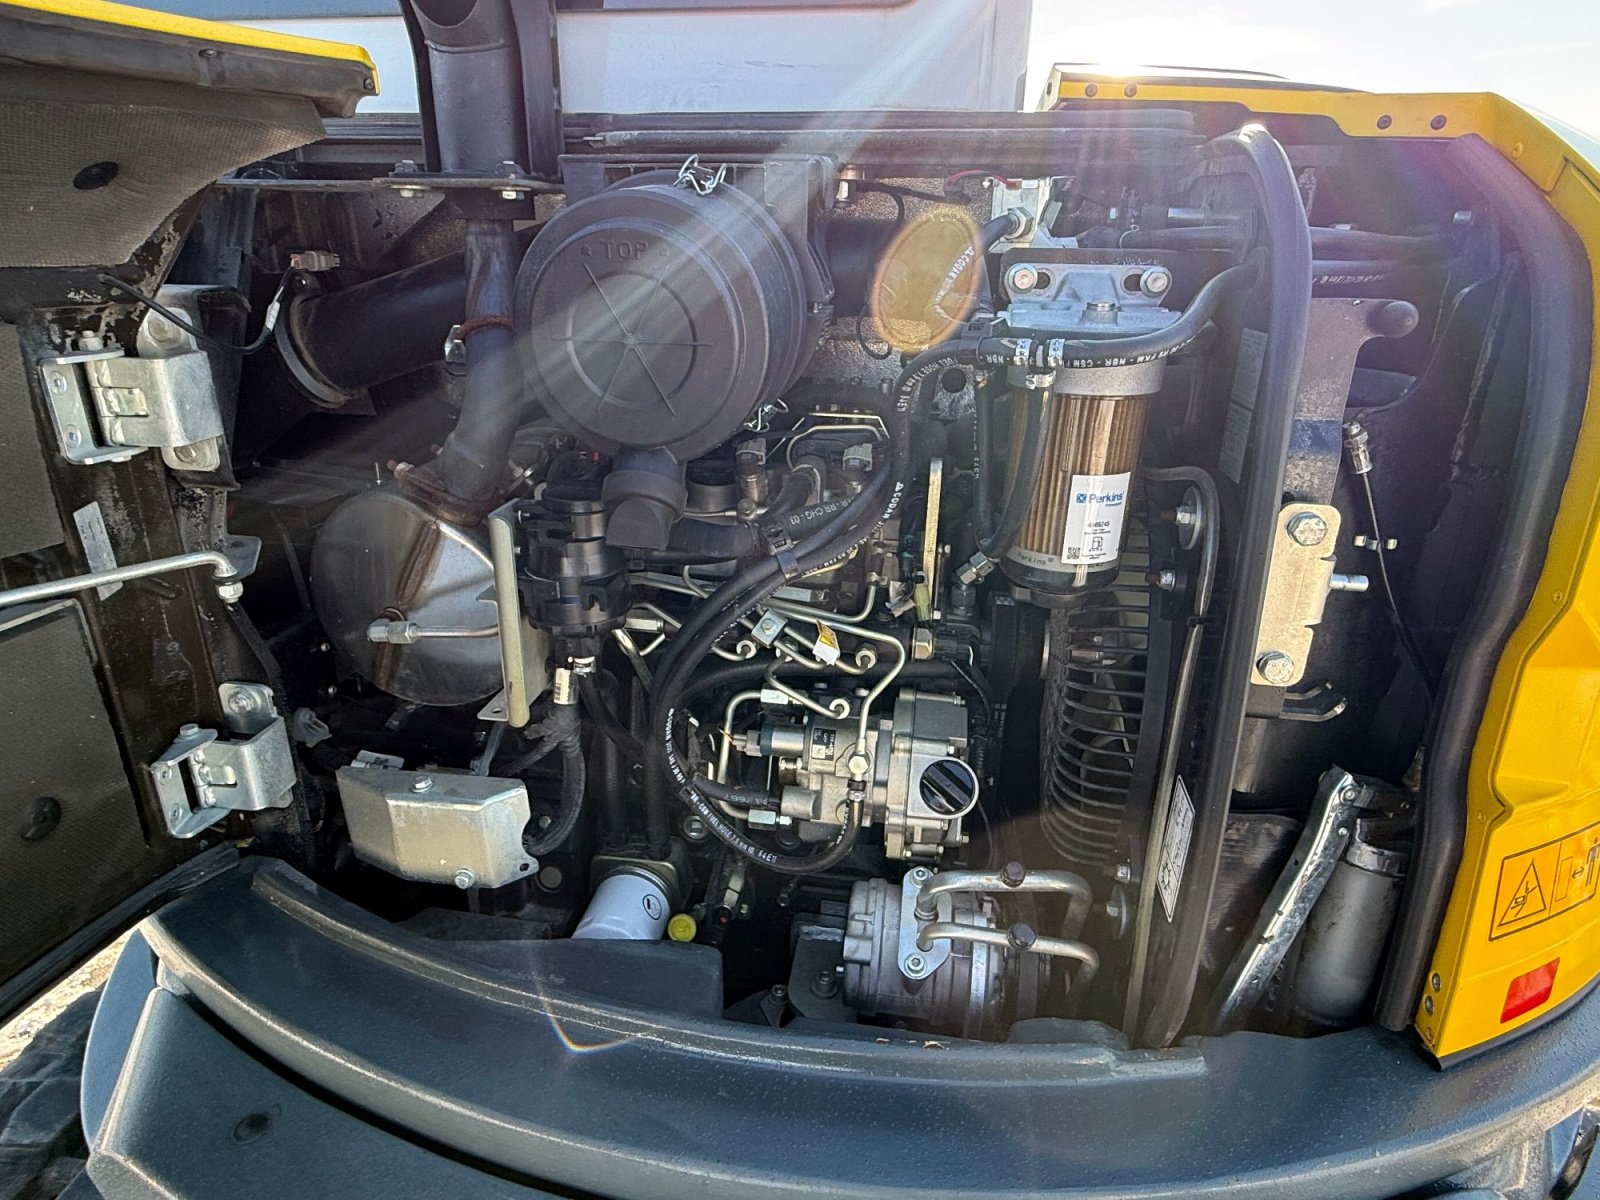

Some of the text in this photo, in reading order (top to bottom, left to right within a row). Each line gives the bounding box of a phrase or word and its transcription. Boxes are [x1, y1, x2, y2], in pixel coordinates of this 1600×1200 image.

[599, 239, 650, 261] TOP
[947, 255, 969, 280] CODAN
[986, 354, 1004, 364] NBR
[1073, 359, 1094, 368] CSM
[1104, 357, 1126, 368] NBR
[882, 492, 902, 519] CODAN
[1088, 492, 1123, 505] Perkins
[789, 503, 837, 525] RR CHG 03
[1017, 552, 1046, 566] Perkins
[707, 813, 720, 827] FUEL
[717, 823, 733, 838] HOSE
